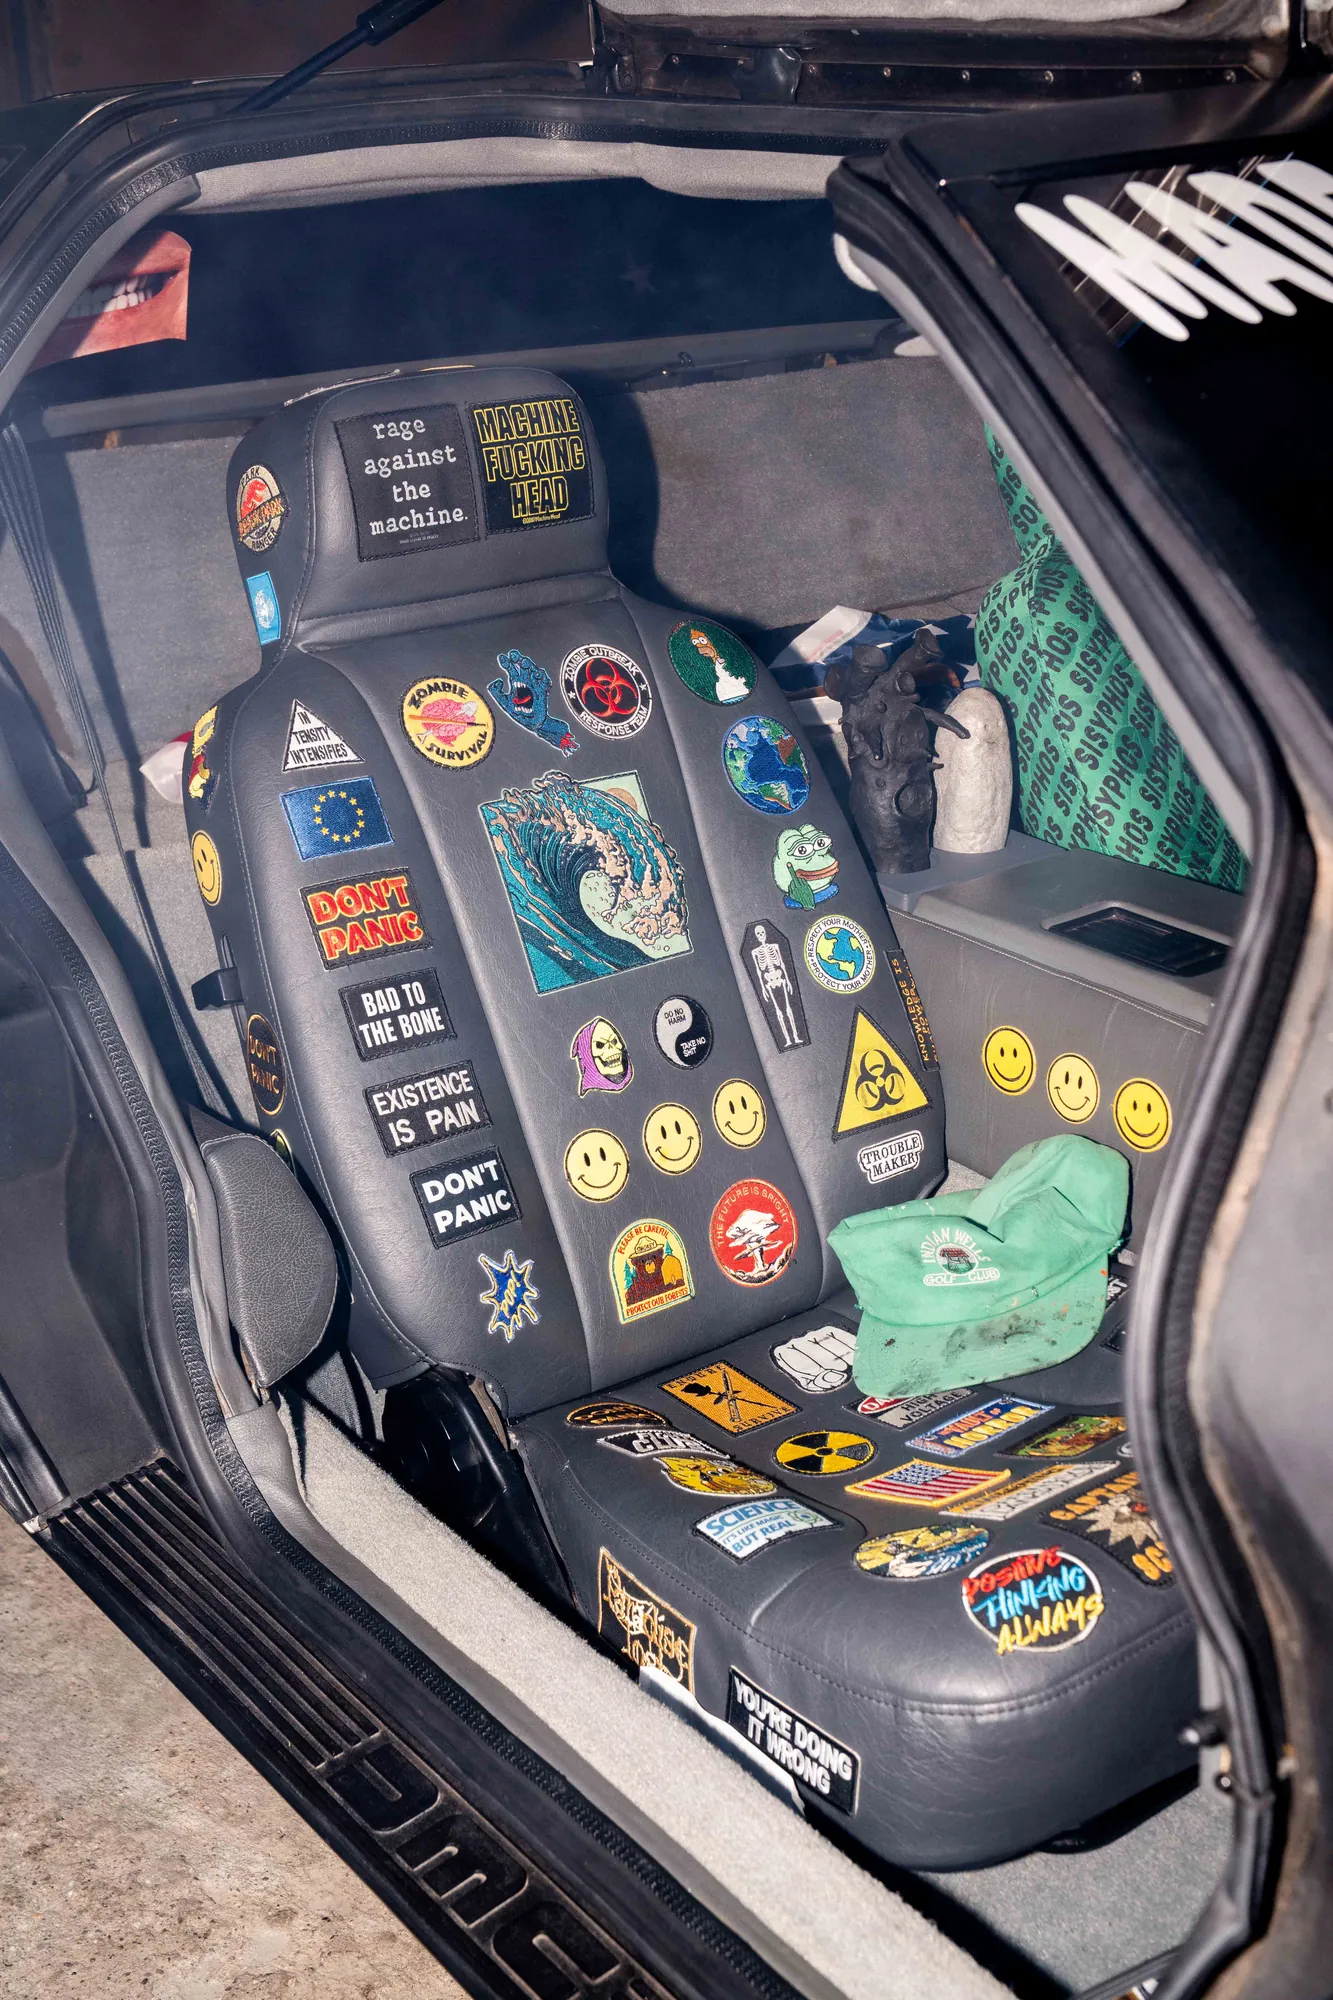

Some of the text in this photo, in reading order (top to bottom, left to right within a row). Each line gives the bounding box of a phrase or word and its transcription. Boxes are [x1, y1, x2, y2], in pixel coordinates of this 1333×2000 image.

[373, 419, 426, 441] rage
[473, 399, 580, 444] MACHINE
[364, 445, 457, 478] against
[482, 436, 586, 482] FUCKING
[240, 466, 260, 487] PARK
[392, 481, 431, 502] the
[509, 476, 569, 519] HEAD
[251, 527, 277, 549] RANGER
[369, 507, 469, 536] machine.
[564, 648, 639, 682] ZOMBIE OUTBREAK
[408, 682, 469, 709] ZOMBIE
[297, 711, 312, 724] IN
[579, 707, 648, 736] RESPONSE TEAM
[1074, 663, 1133, 771] SISYPHOS
[292, 727, 331, 744] TENSITY
[426, 730, 488, 761] SURVIVAL
[290, 743, 348, 764] INTENSIFIES
[1024, 737, 1060, 837] ISYPHOS
[1090, 734, 1143, 840] ISYPHOS
[307, 876, 410, 925] DON'T
[318, 910, 424, 960] PANIC
[808, 918, 868, 957] RESPECT YOUR MOTHER
[811, 950, 873, 990] PROTECT YOUR MOTHER
[891, 958, 902, 975] IS
[361, 981, 426, 1017] BAD TO
[664, 1008, 684, 1020] DO NO
[359, 1007, 445, 1048] THE BONE
[668, 1015, 686, 1025] HARM
[899, 980, 929, 1061] KNOWLEDGE
[249, 1035, 276, 1066] DON'T
[680, 1037, 706, 1050] TAKE NO
[683, 1047, 697, 1057] SHIT
[251, 1063, 280, 1094] PANIC
[372, 1069, 473, 1116] EXISTENCE
[388, 1098, 481, 1147] IS PAIN
[862, 1135, 920, 1162] TROUBLE
[872, 1153, 919, 1177] MAKER
[422, 1159, 499, 1204] DON'T
[433, 1189, 512, 1234] PANIC
[719, 1187, 749, 1224] FUTURE
[750, 1186, 760, 1195] IS
[761, 1189, 789, 1224] BRIGHT
[618, 1224, 669, 1255] PLEASE BE CAREFUL
[920, 1228, 991, 1264] INDIAN WELLS
[927, 1269, 998, 1284] GOLF CLUB
[626, 1286, 689, 1317] PROTECT OUR FORESTS
[667, 1364, 726, 1390] ENDURE
[732, 1406, 790, 1433] SURVIVE
[900, 1391, 963, 1423] VOLTAGE
[948, 1410, 993, 1434] VAULT
[943, 1405, 1040, 1449] HORROR
[705, 1500, 799, 1536] SCIENCE
[722, 1515, 782, 1545] IT'S LIKE MAGIC
[732, 1520, 794, 1553] BUT REAL
[961, 1545, 1065, 1604] POSITIVE
[972, 1565, 1087, 1628] THINKING
[997, 1594, 1104, 1656] ALWAYS
[733, 1675, 853, 1781] YOU'RE DOING
[748, 1714, 830, 1794] IT WRONG
